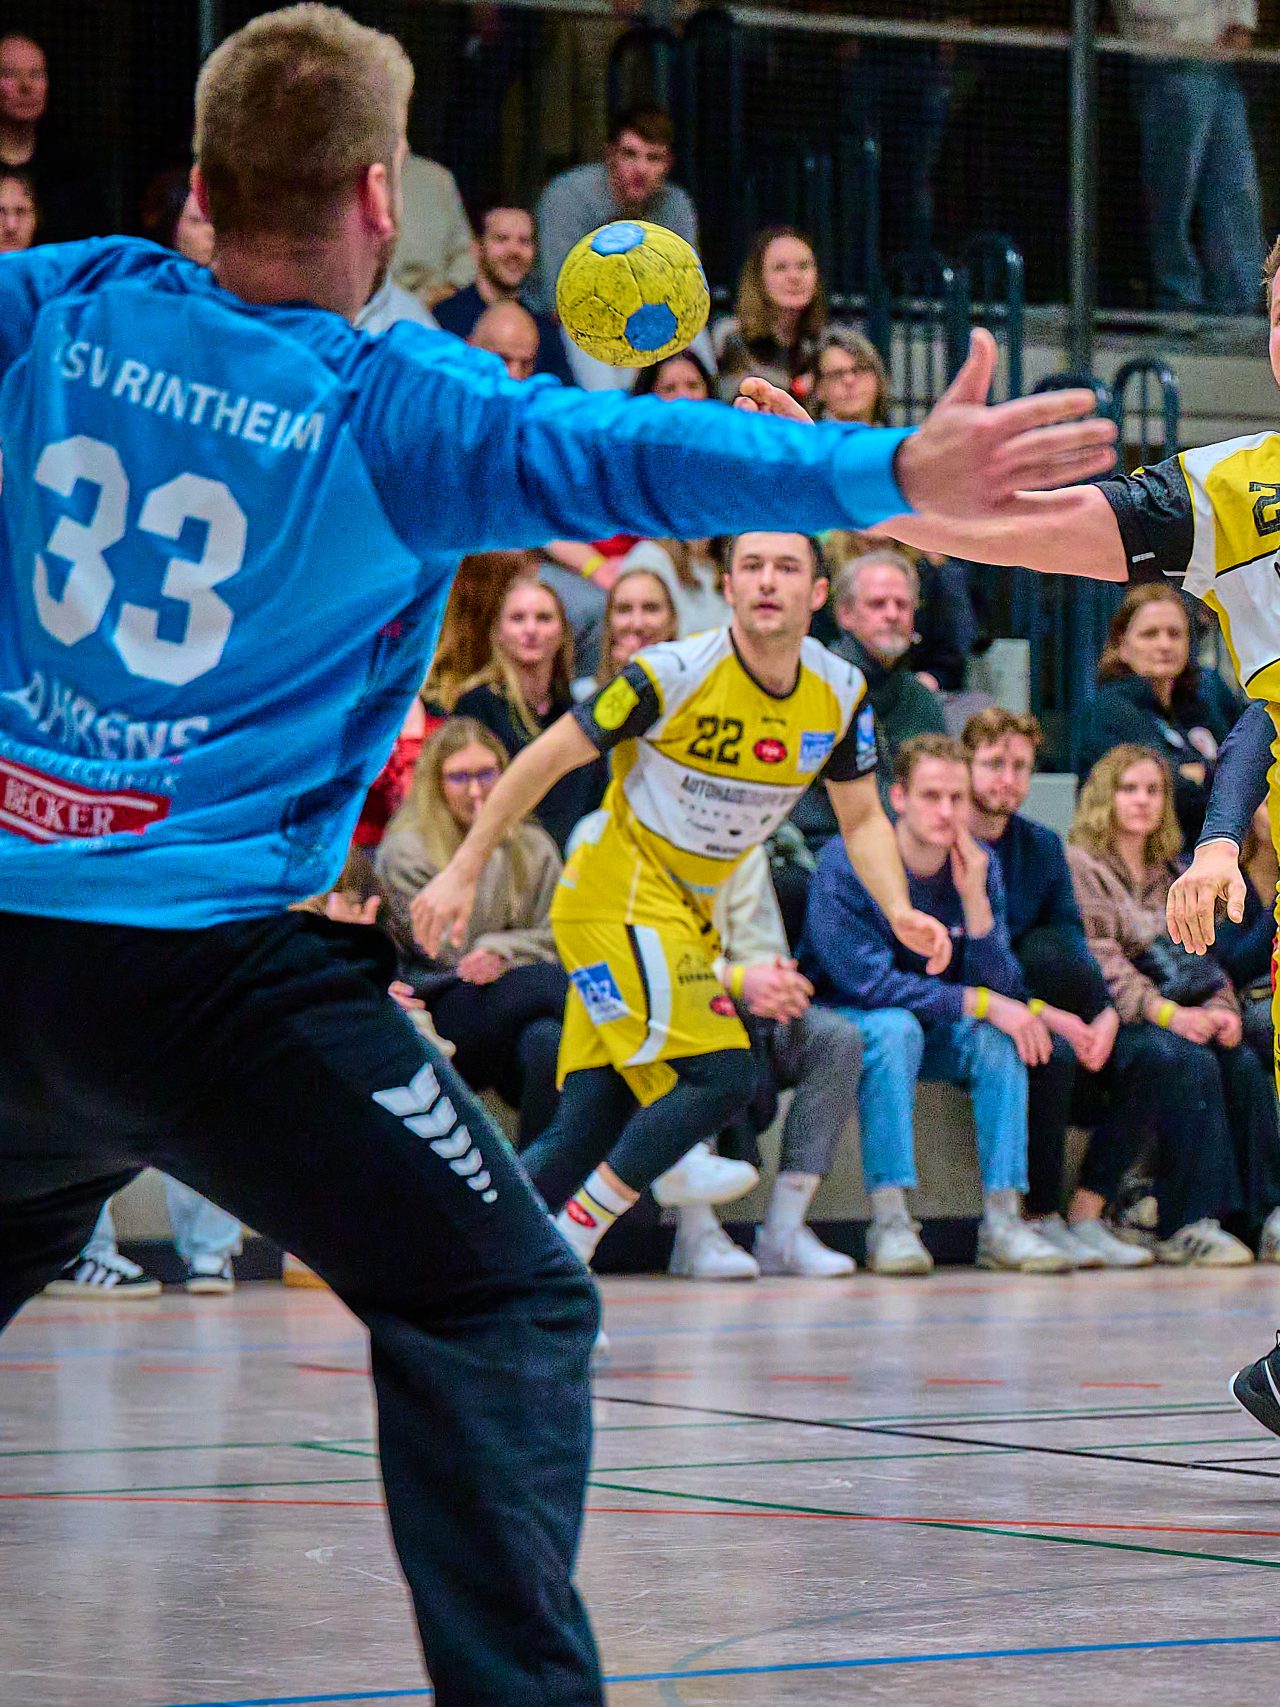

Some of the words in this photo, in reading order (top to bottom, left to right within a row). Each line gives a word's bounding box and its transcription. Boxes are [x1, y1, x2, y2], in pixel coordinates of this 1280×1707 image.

[111, 358, 326, 455] RINTHEIM
[32, 434, 248, 687] 33
[686, 715, 745, 766] 22
